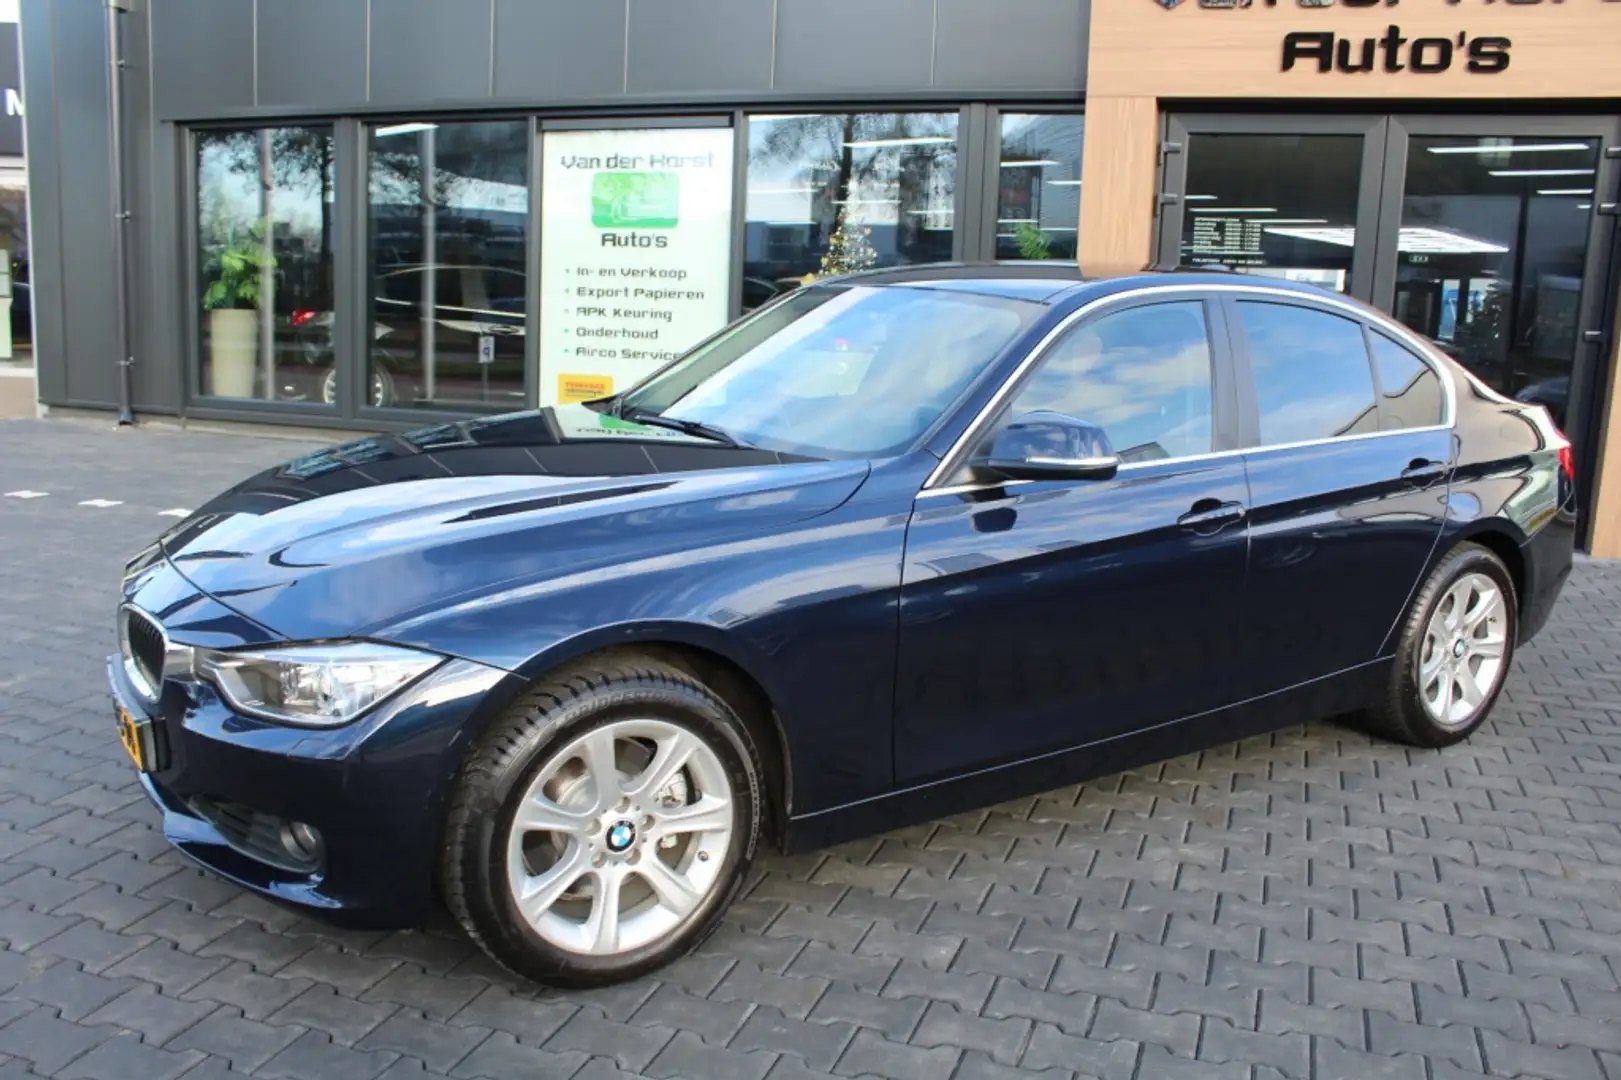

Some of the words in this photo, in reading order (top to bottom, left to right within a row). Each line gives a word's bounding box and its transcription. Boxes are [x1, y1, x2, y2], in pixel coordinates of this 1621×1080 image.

[1280, 25, 1512, 74] Auto's
[561, 155, 601, 169] Van
[606, 153, 643, 169] der
[649, 151, 714, 168] Horst
[601, 231, 668, 248] Auto's
[598, 268, 616, 277] en
[620, 268, 688, 281] Verkoop
[576, 286, 629, 299] Export
[633, 287, 705, 300] Papieren
[576, 307, 607, 317] APK
[612, 308, 673, 322] Keuring
[576, 327, 659, 340] Onderhoud
[576, 347, 617, 358] Airco
